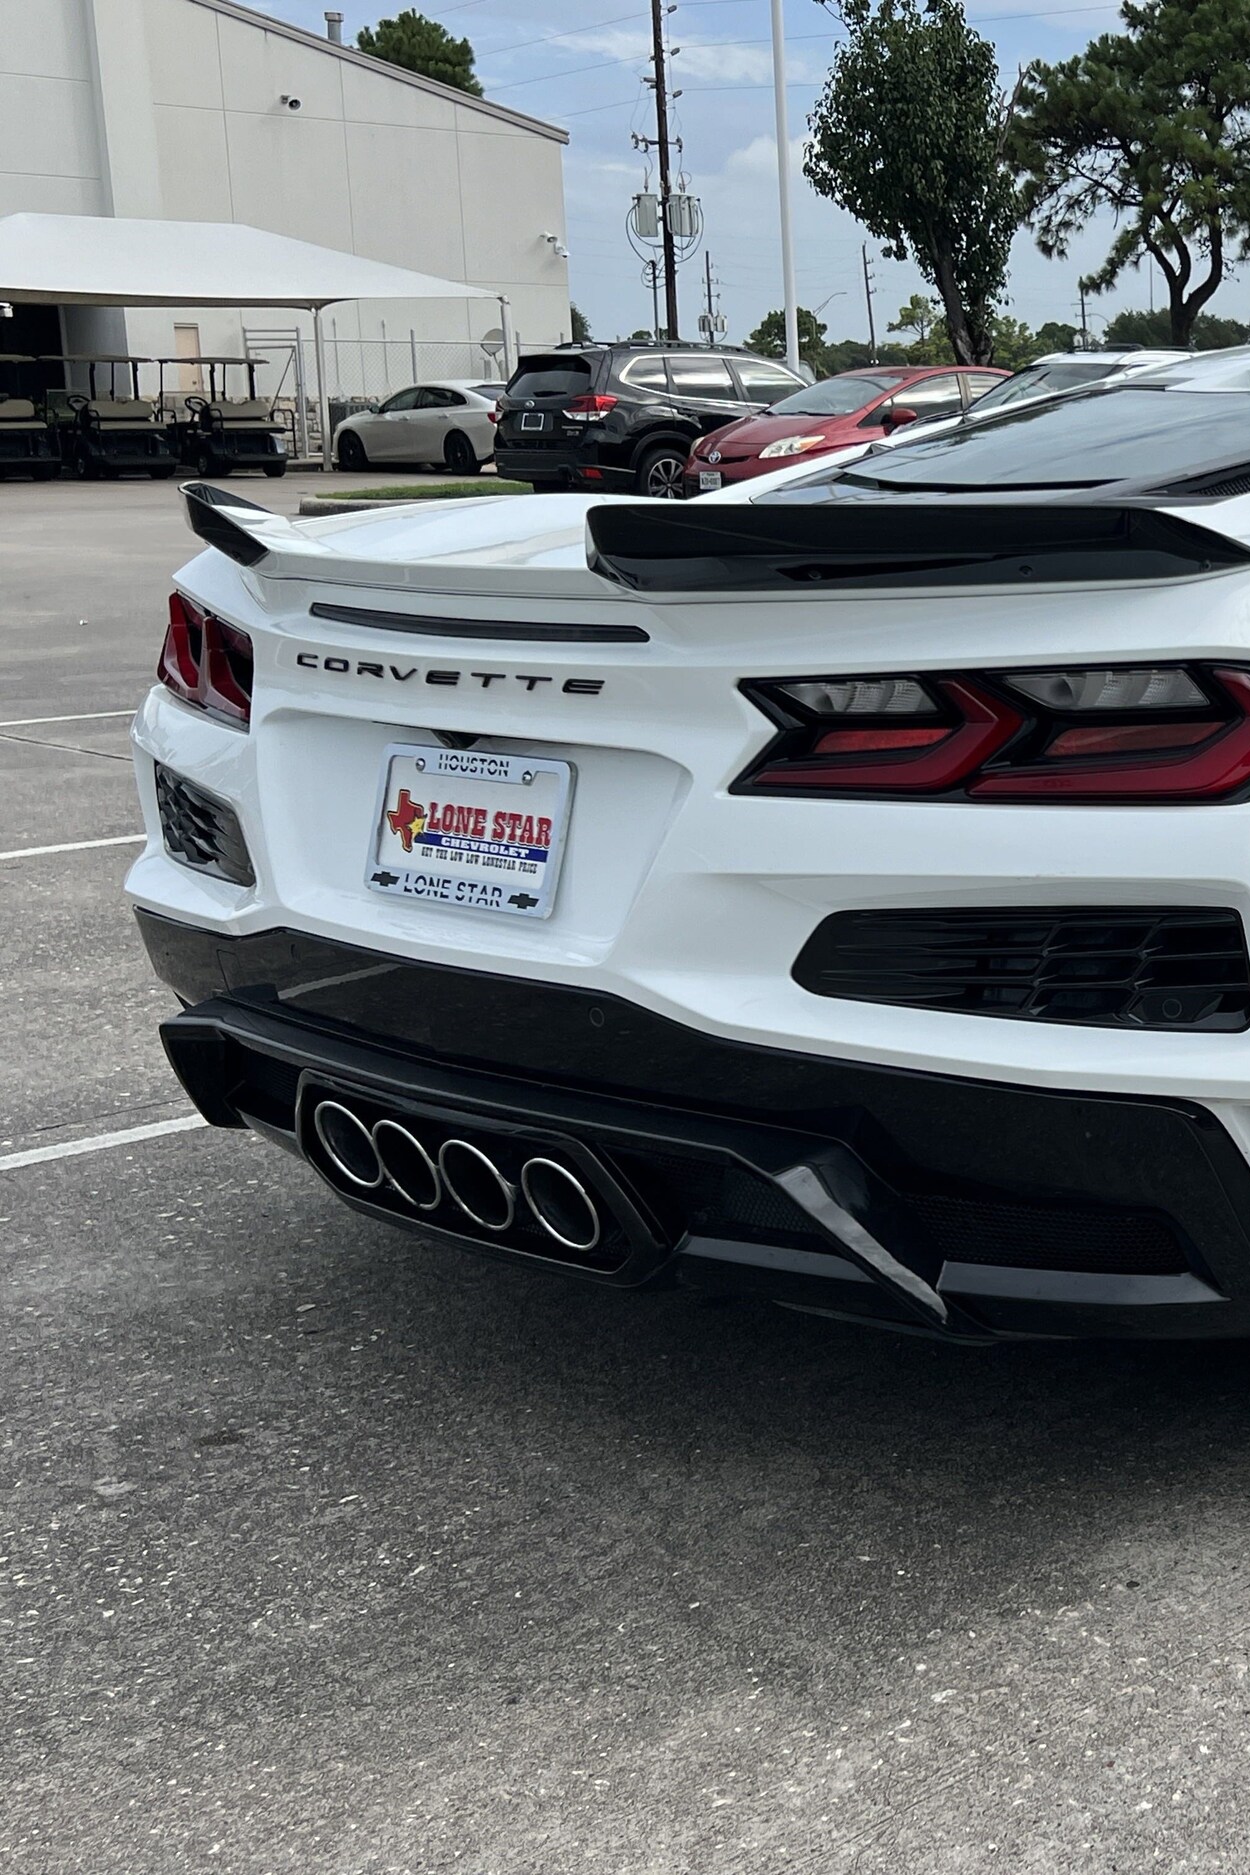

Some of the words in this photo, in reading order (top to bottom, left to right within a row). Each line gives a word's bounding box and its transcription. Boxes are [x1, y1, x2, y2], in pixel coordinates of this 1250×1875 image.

[296, 652, 606, 696] CORVETTE
[438, 753, 510, 777] HOUSTON
[427, 801, 487, 839] LONE
[491, 810, 553, 848] STAR
[435, 848, 449, 861] THE
[450, 850, 464, 862] LOW
[465, 853, 480, 865] LOW
[482, 856, 516, 872] LONESTAR
[518, 863, 539, 875] PRICE
[440, 836, 530, 858] CHEVROLET
[403, 872, 452, 899] LONE
[455, 881, 503, 908] STAR
